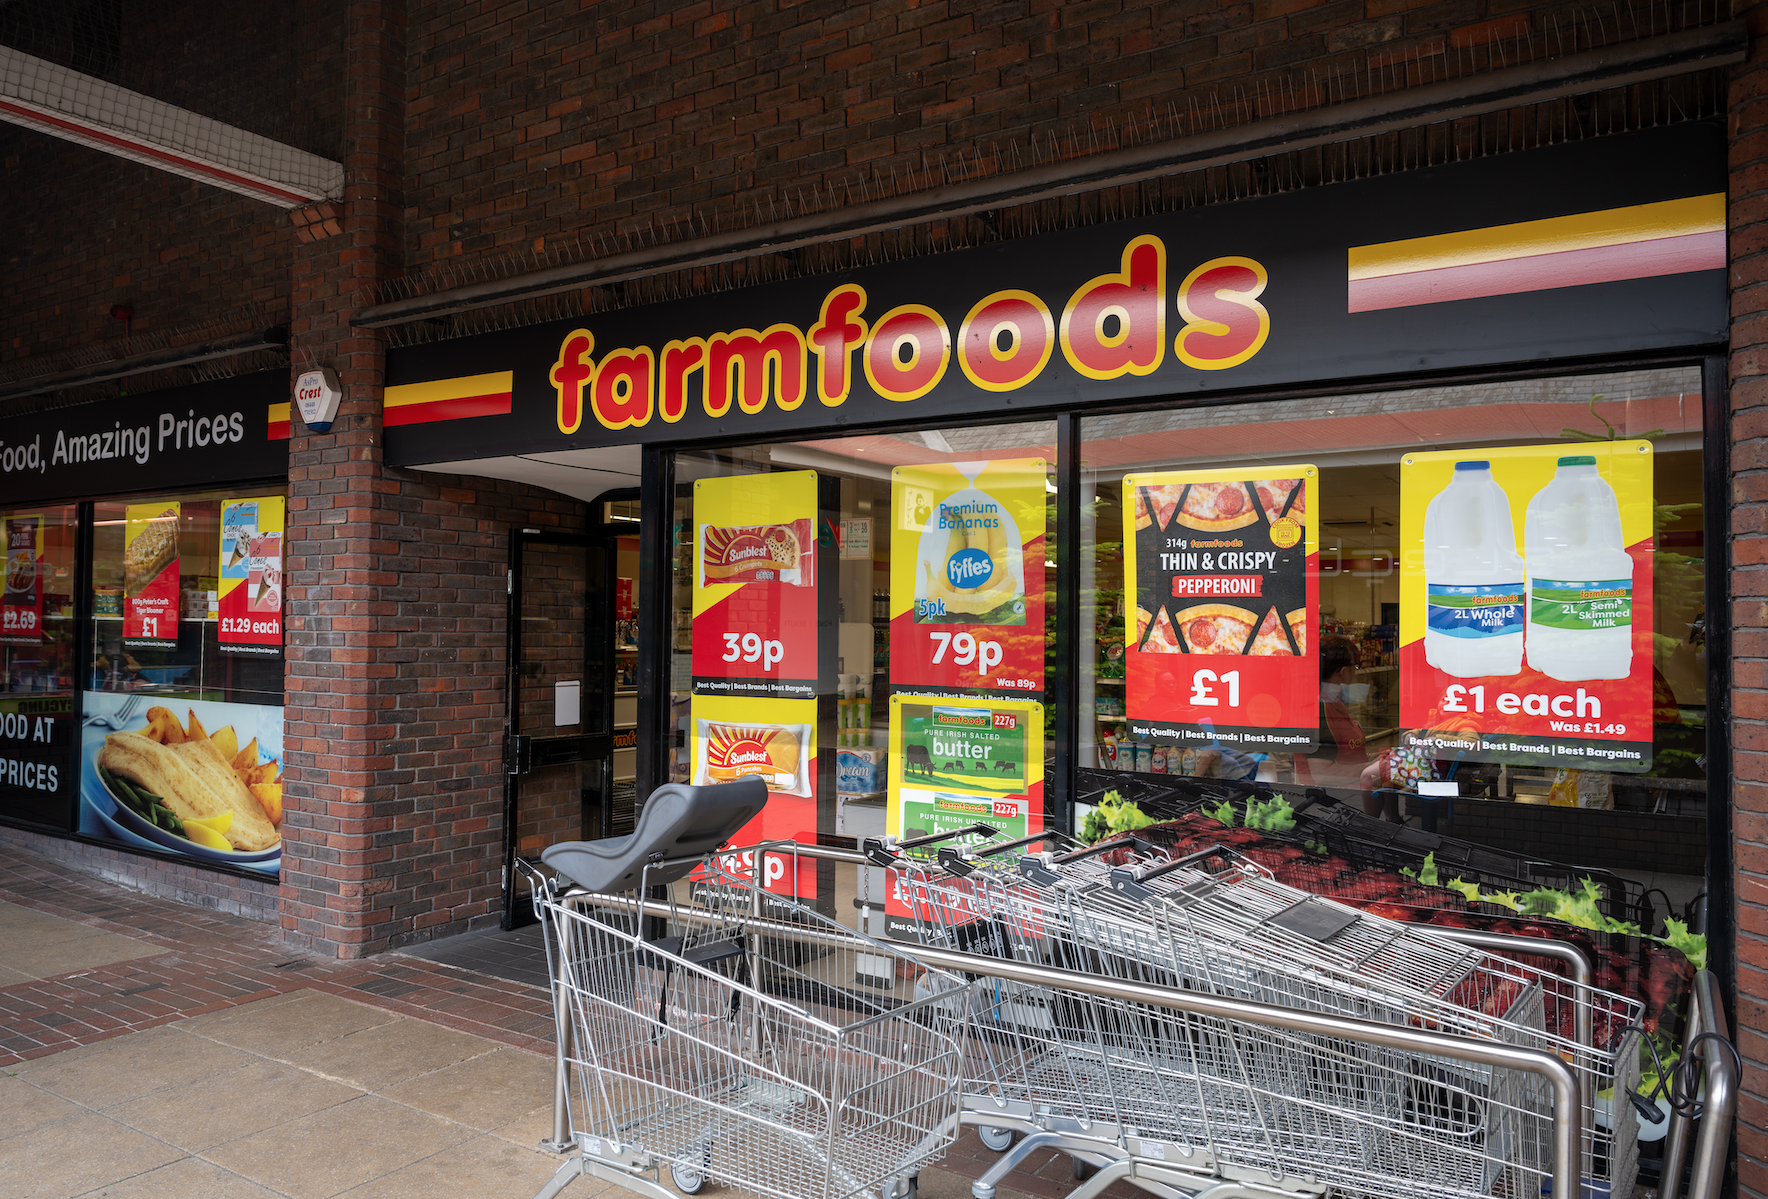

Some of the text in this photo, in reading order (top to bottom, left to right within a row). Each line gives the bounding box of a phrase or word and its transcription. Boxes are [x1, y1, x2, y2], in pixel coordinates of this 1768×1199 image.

[549, 234, 1269, 435] farmfoods
[299, 386, 321, 400] Crest
[52, 421, 150, 465] Amazing
[158, 409, 244, 452] Prices
[940, 500, 998, 516] Premium
[939, 518, 999, 529] Bananas
[1166, 538, 1243, 549] 314g farmfoods
[729, 545, 767, 562] Sunblest
[1160, 551, 1277, 570] THIN & CRISPY
[739, 562, 762, 571] Crumpets
[949, 557, 991, 583] fyffes
[1178, 579, 1256, 594] PEPPERONI
[1580, 588, 1626, 599] farmfoods
[1472, 594, 1519, 605] farmfoods
[1562, 600, 1617, 614] 2L Semi
[919, 597, 947, 620] 5pk
[1454, 608, 1515, 620] 2L Whole
[1578, 609, 1630, 619] Skimmed
[3, 611, 35, 629] £2.69
[142, 617, 157, 637] £1
[221, 618, 279, 634] £1.29 each
[1481, 618, 1504, 627] Milk
[1592, 618, 1616, 627] Milk
[722, 632, 784, 671] 39p
[929, 631, 1003, 676] 79p
[710, 682, 730, 690] Quality
[785, 685, 812, 693] Bargains
[996, 678, 1036, 690] Was 89p
[1189, 668, 1240, 708] £1
[1443, 683, 1601, 718] £1 each
[938, 714, 1016, 728] farmfoods 227g
[1550, 720, 1626, 735] Was £1.49
[33, 716, 55, 743] AT
[924, 729, 944, 737] PURE
[970, 732, 1000, 740] SALTED
[1132, 726, 1310, 746] Best Quality Best Brands Best Bargains
[932, 737, 992, 759] butter
[1409, 737, 1641, 760] Best Quality Best Brands Best Bargains
[730, 750, 767, 764] Sunblest
[0, 758, 58, 792] PRICES
[736, 765, 762, 776] 6 Pancakes
[939, 800, 1017, 818] farmfoods 227g
[920, 812, 939, 821] PURE
[942, 815, 963, 823] IRISH
[890, 922, 906, 931] Best
